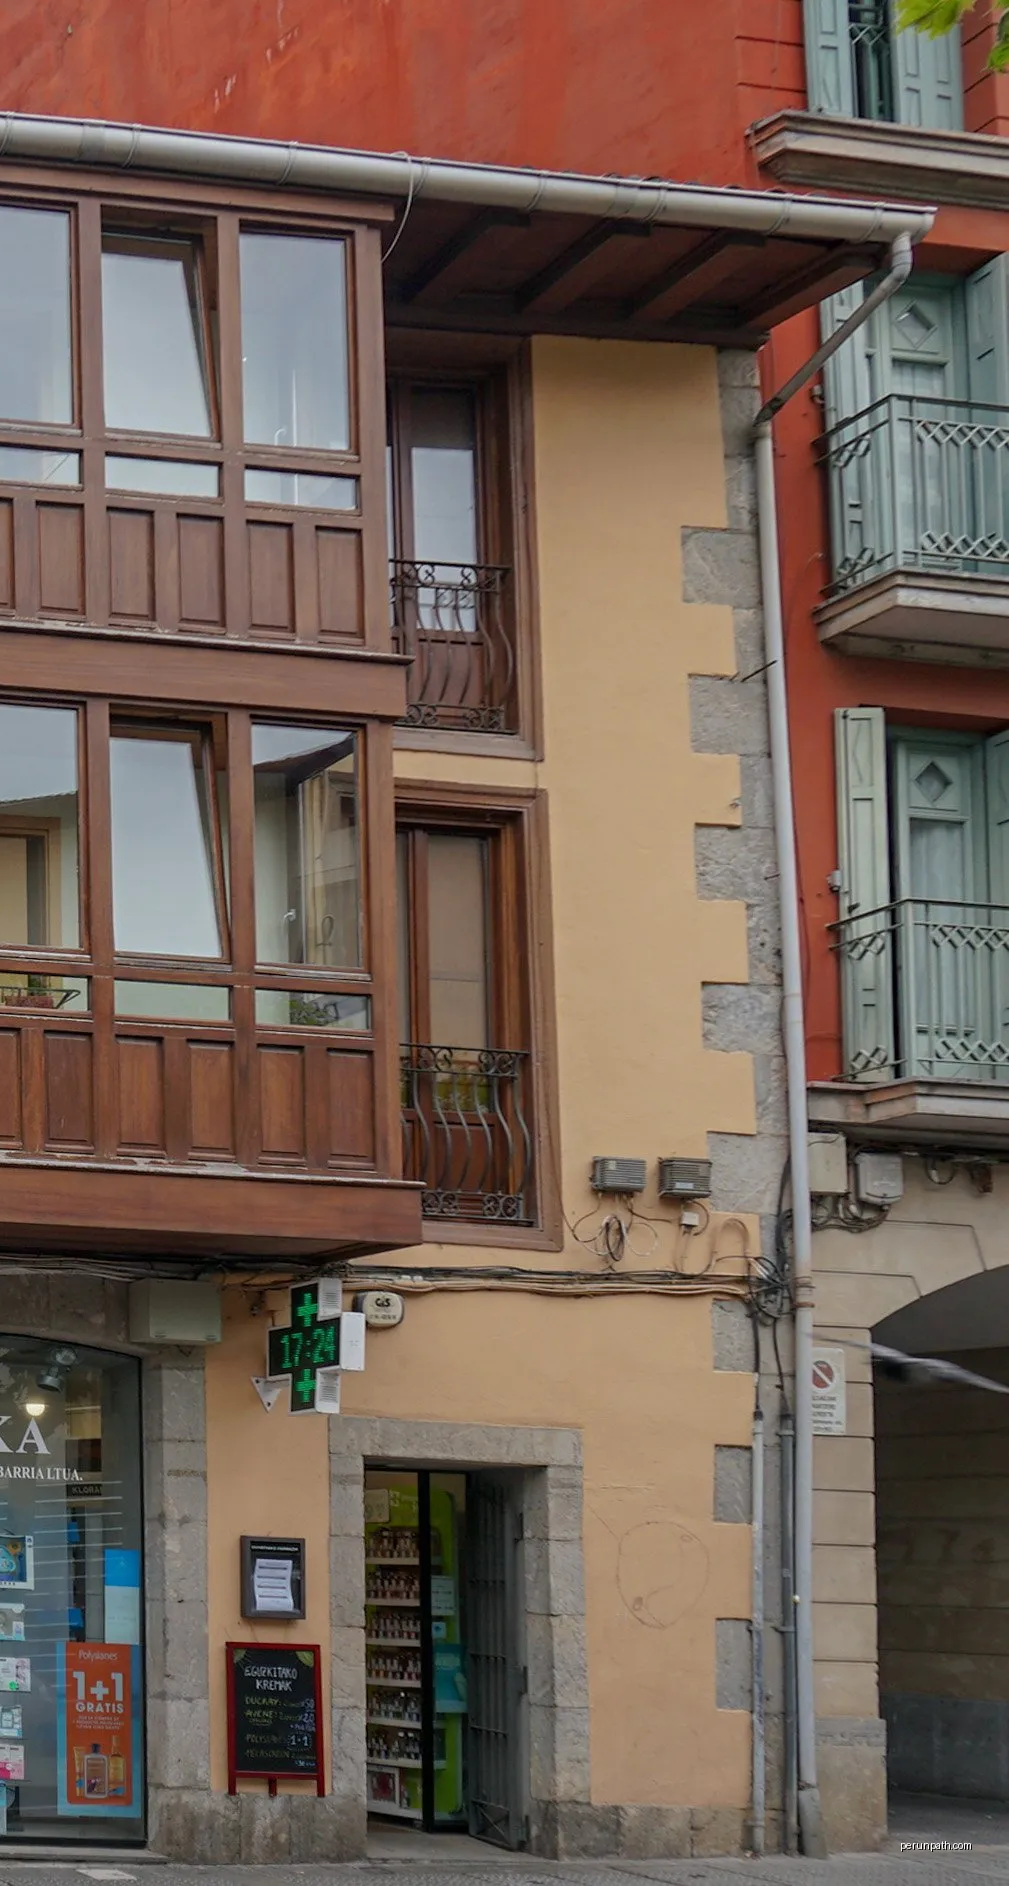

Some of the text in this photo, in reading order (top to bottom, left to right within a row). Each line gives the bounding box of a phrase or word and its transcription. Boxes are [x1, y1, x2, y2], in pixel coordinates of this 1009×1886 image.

[280, 1326, 336, 1368] 17:24
[47, 1467, 84, 1481] LTUA.
[72, 1671, 124, 1702] 1+1
[75, 1701, 124, 1714] GRATIS
